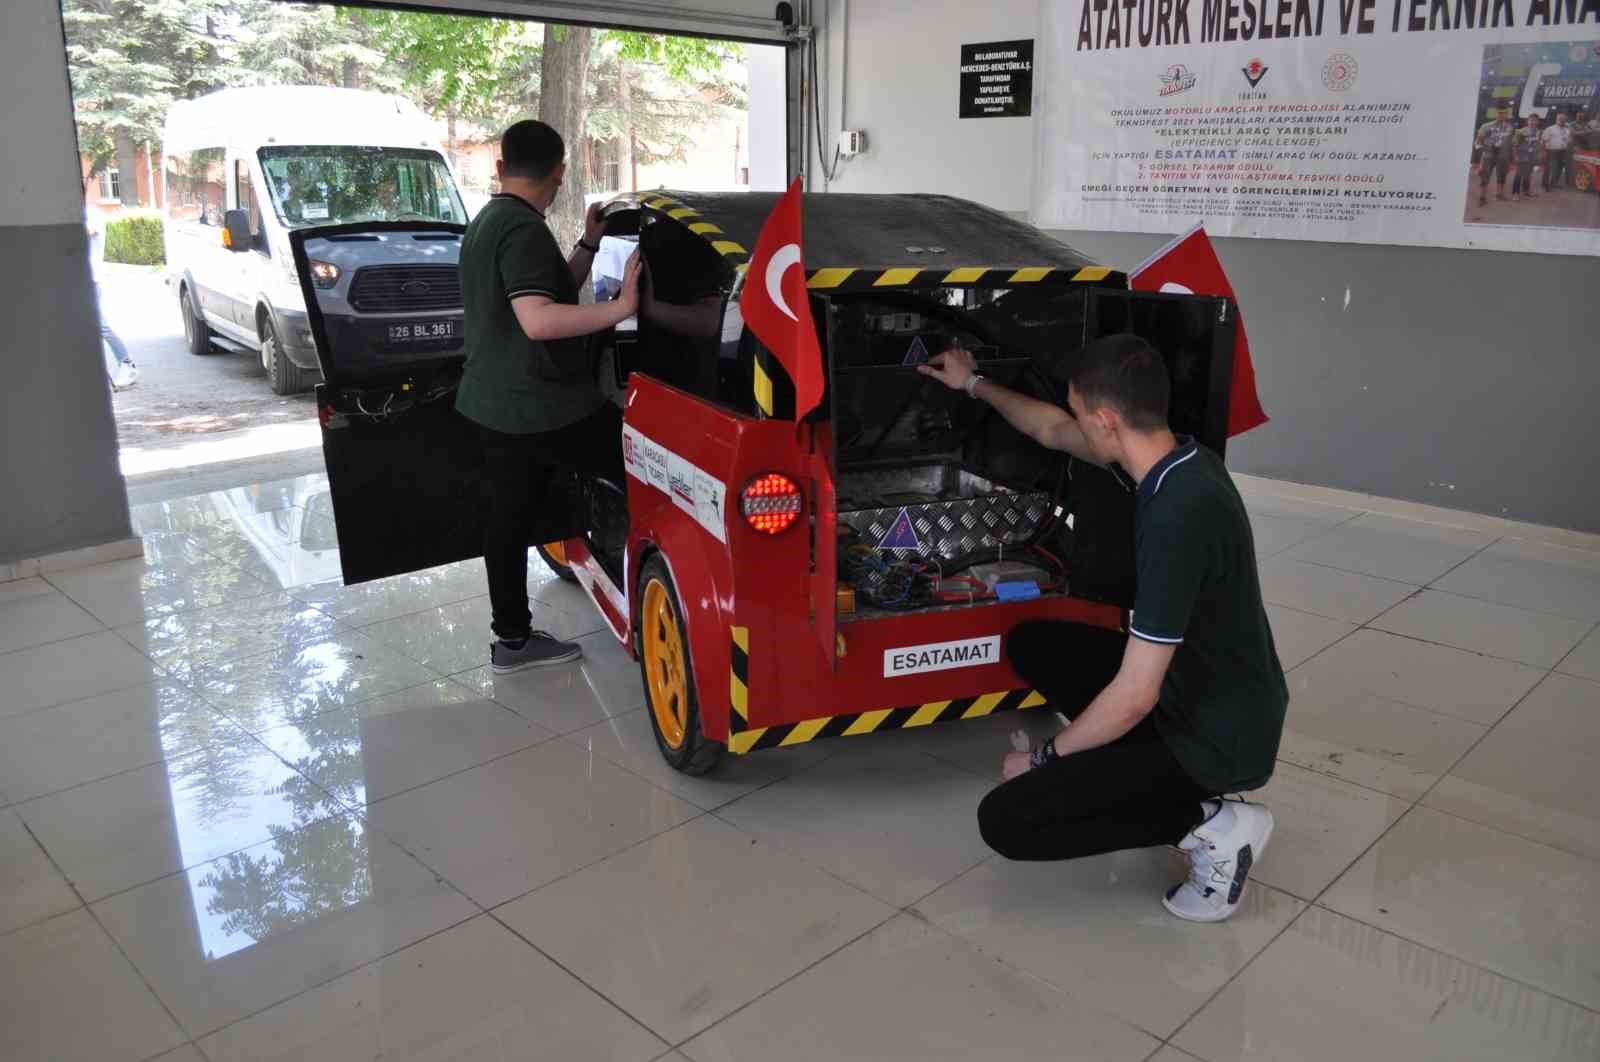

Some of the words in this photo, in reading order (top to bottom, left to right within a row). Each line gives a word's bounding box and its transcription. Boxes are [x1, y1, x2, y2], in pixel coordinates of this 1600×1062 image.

[961, 63, 1005, 73] MERCEDES-BENZ
[1111, 108, 1162, 117] OKULUMUZ
[1165, 106, 1212, 115] MOTORLU
[1213, 105, 1263, 114] ARAÇLAR
[1343, 103, 1411, 111] ALANIMIZIN
[1115, 119, 1169, 127] TEKNOFEST
[1172, 118, 1193, 126] 2021
[1197, 116, 1265, 126] YARIŞMALARI
[1268, 115, 1340, 124] KAPSAMINDA
[1343, 114, 1404, 124] KATILDIĞI
[1236, 126, 1270, 136] ARAÇ
[1276, 126, 1348, 136] YARIŞLARI
[1113, 151, 1149, 159] YAPTIĞI
[1154, 149, 1238, 160] ESATAMAT
[1276, 151, 1306, 161] ARAÇ
[1328, 151, 1360, 160] ÖDÜL
[1192, 163, 1234, 171] TASARIM
[1238, 162, 1273, 171] ÖDÜLÜ
[1150, 172, 1187, 180] TANITIM
[1206, 173, 1293, 182] YAYGINLAŞTIRMA
[1344, 173, 1385, 184] ÖDÜLÜ
[1081, 183, 1112, 192] EMEĞİ
[1115, 184, 1149, 194] GEÇEN
[1153, 184, 1210, 193] ÖĞRETMEN
[1215, 186, 1228, 194] VE
[1343, 189, 1437, 200] KUTLUYORUZ.
[414, 325, 430, 336] BL
[432, 324, 450, 335] 361
[893, 642, 992, 670] ESATAMAT
